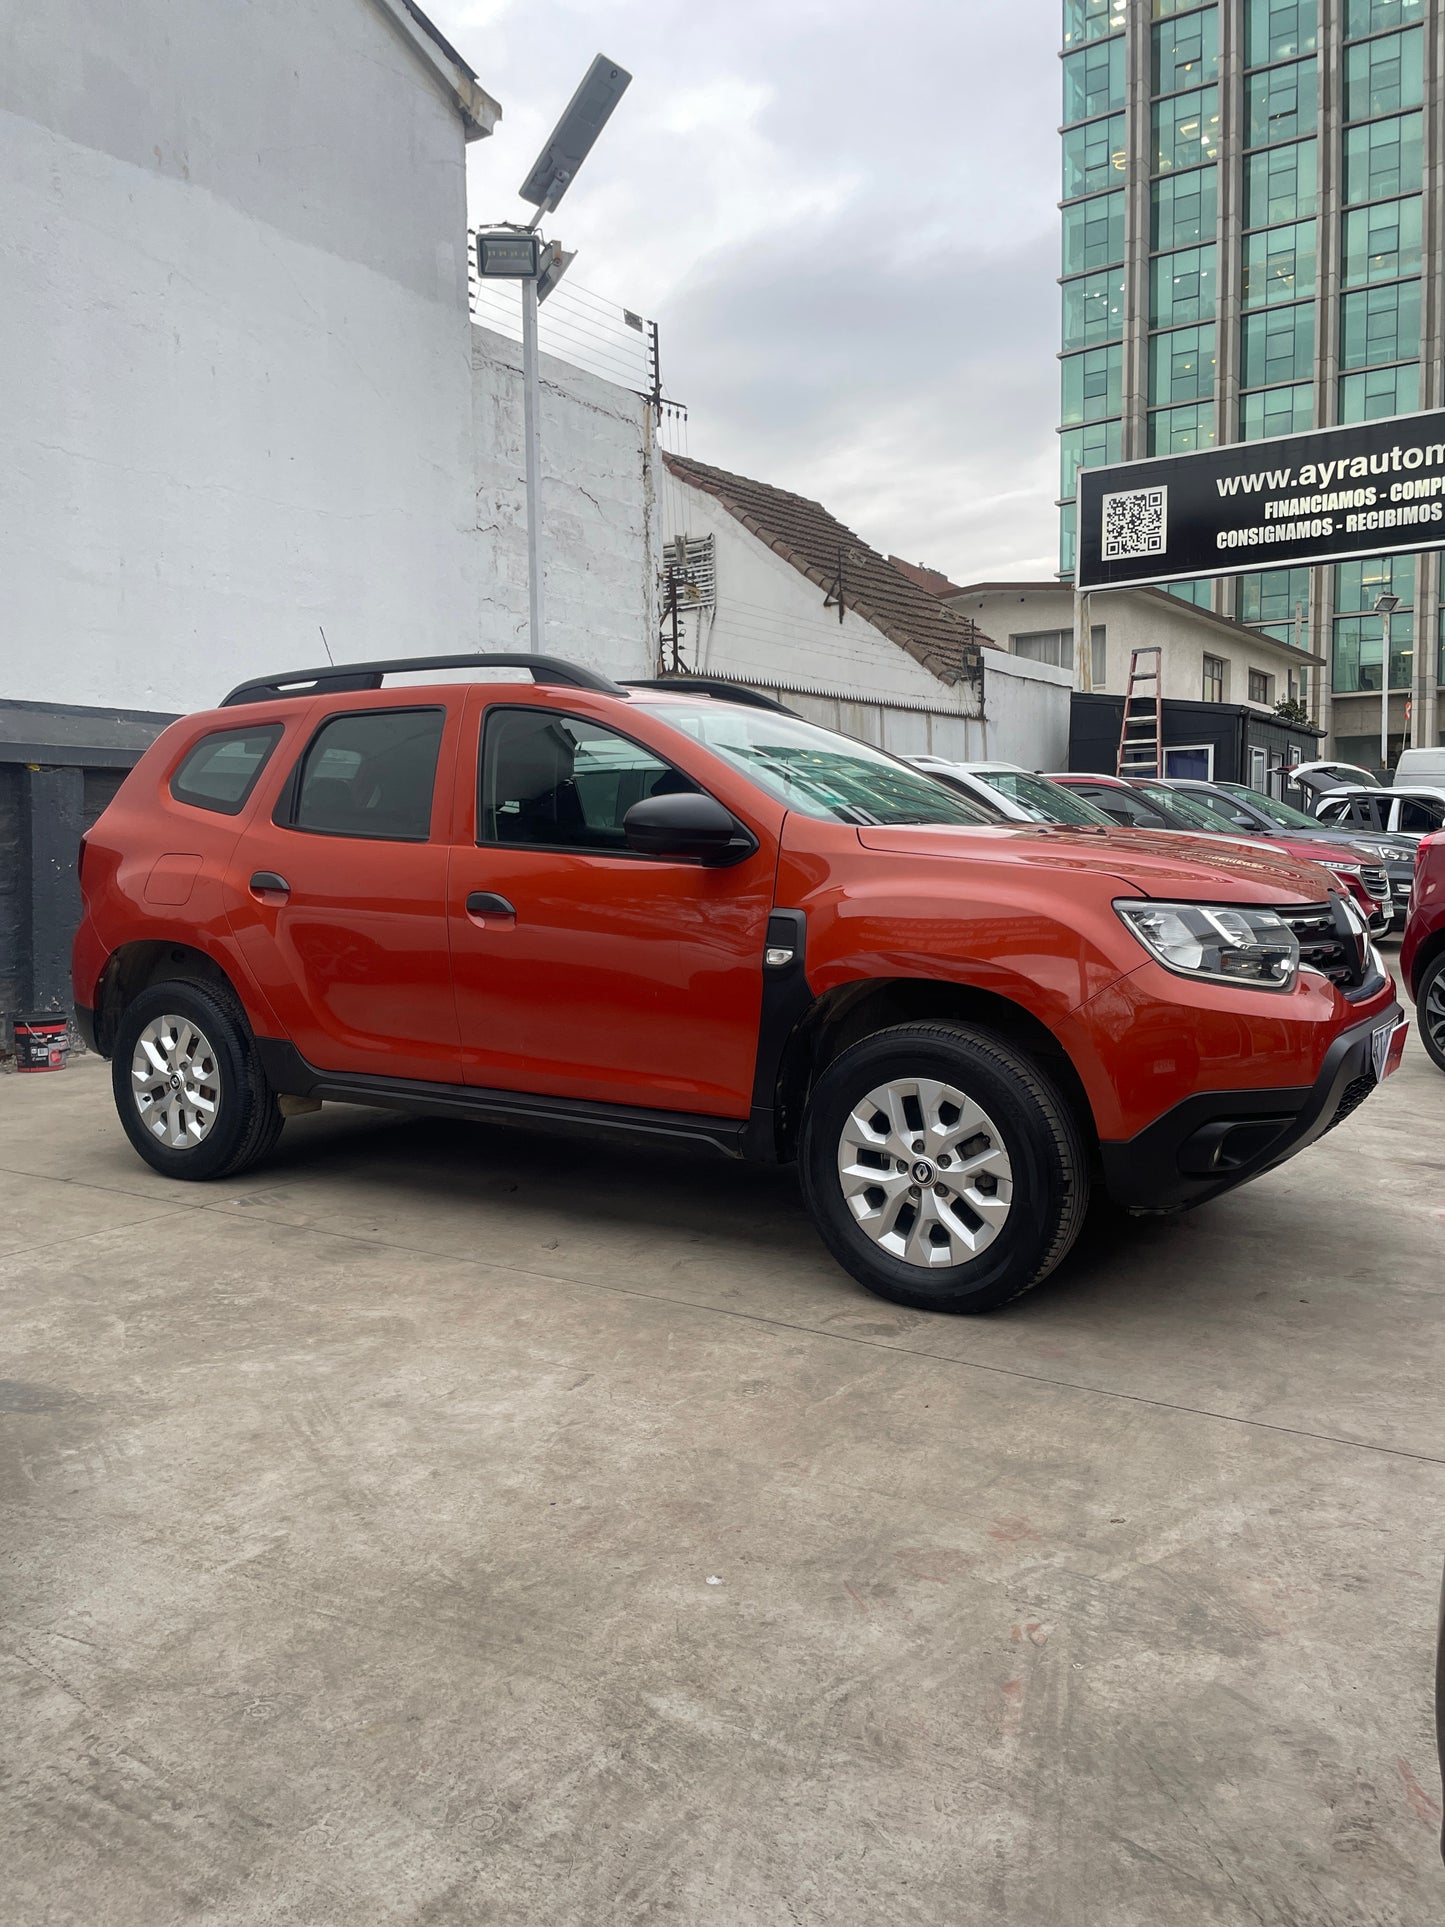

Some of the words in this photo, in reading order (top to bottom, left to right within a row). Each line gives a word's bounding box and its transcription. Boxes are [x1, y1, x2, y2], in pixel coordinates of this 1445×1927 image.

[1264, 486, 1377, 520] FINANCIAMOS
[1390, 475, 1445, 502] COMP
[1216, 517, 1333, 549] CONSIGNAMOS
[1346, 502, 1443, 532] RECIBIMOS
